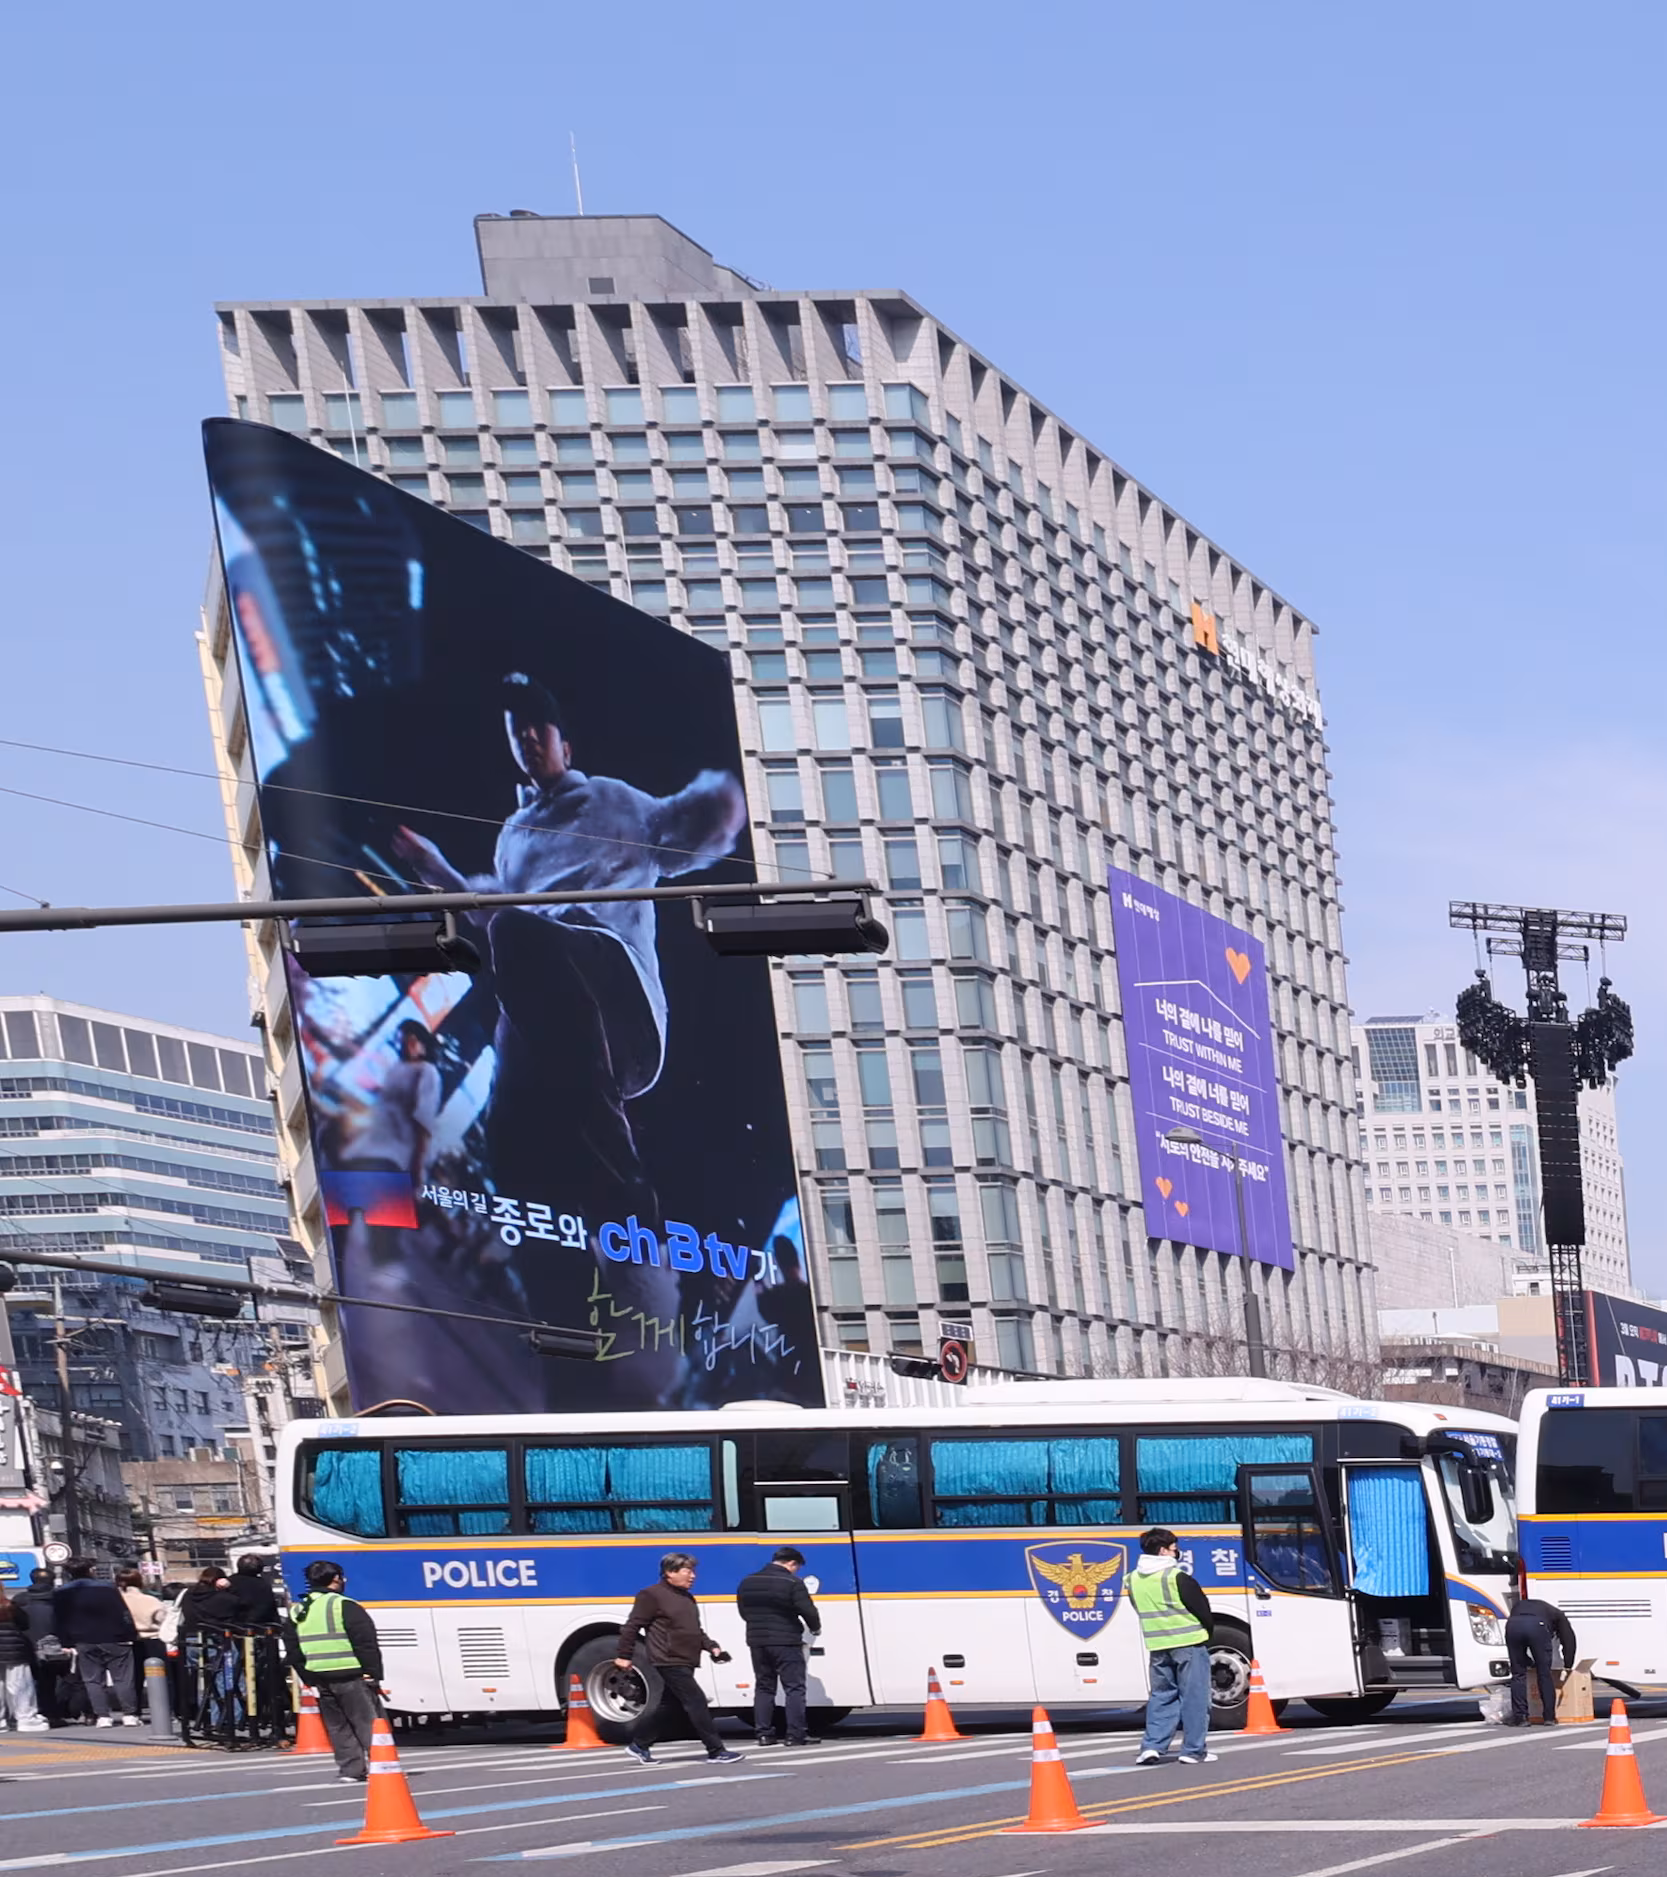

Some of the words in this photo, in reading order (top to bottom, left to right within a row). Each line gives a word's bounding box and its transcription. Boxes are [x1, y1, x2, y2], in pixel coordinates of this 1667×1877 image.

[1155, 998, 1179, 1026] 너의
[1179, 1006, 1200, 1035] 곁에
[1201, 1016, 1223, 1043] 나를
[1223, 1026, 1244, 1053] 믿어
[1162, 1029, 1195, 1057] TRUST
[1195, 1039, 1228, 1068] WITHIN
[1227, 1053, 1243, 1074] ME
[1162, 1065, 1186, 1093] 나의
[1186, 1074, 1206, 1103] 곁에
[1208, 1083, 1229, 1110] 너를
[1229, 1092, 1250, 1117] 믿어
[1169, 1095, 1200, 1122] TRUST
[1201, 1107, 1234, 1133] BESIDE
[1233, 1118, 1250, 1138] ME
[421, 1183, 468, 1211] 서울의
[470, 1190, 487, 1216] 길
[490, 1194, 589, 1252] 종로와
[1551, 1395, 1580, 1405] 41기-1
[422, 1560, 539, 1588] POLICE
[1062, 1610, 1104, 1622] POLICE
